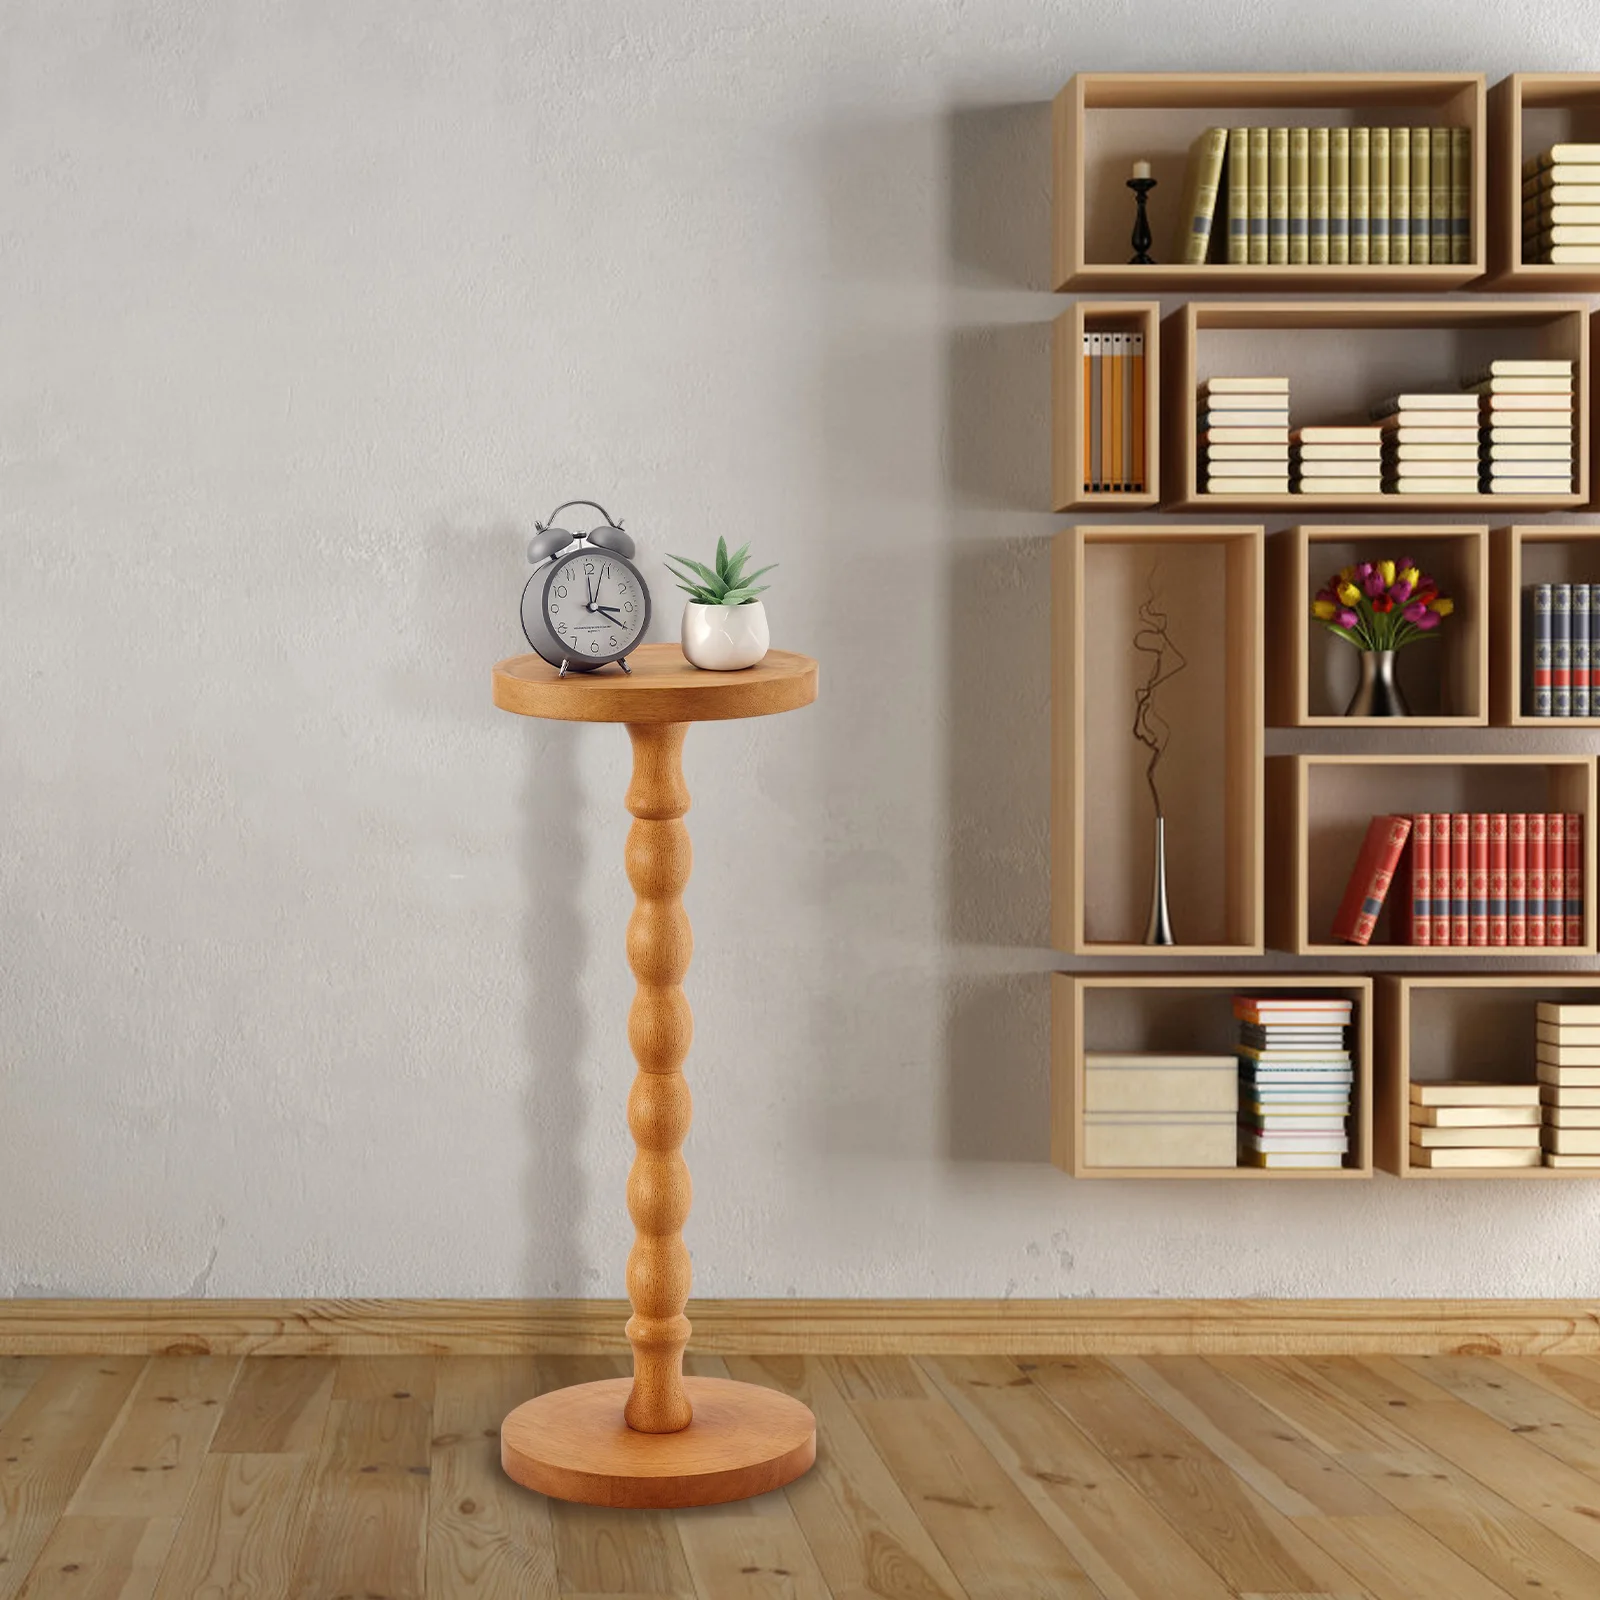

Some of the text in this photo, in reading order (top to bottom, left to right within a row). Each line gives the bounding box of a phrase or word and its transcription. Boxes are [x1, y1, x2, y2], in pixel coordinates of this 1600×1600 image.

[584, 563, 594, 575] 12
[553, 585, 567, 598] 10
[570, 636, 577, 649] 7
[591, 640, 599, 653] 6
